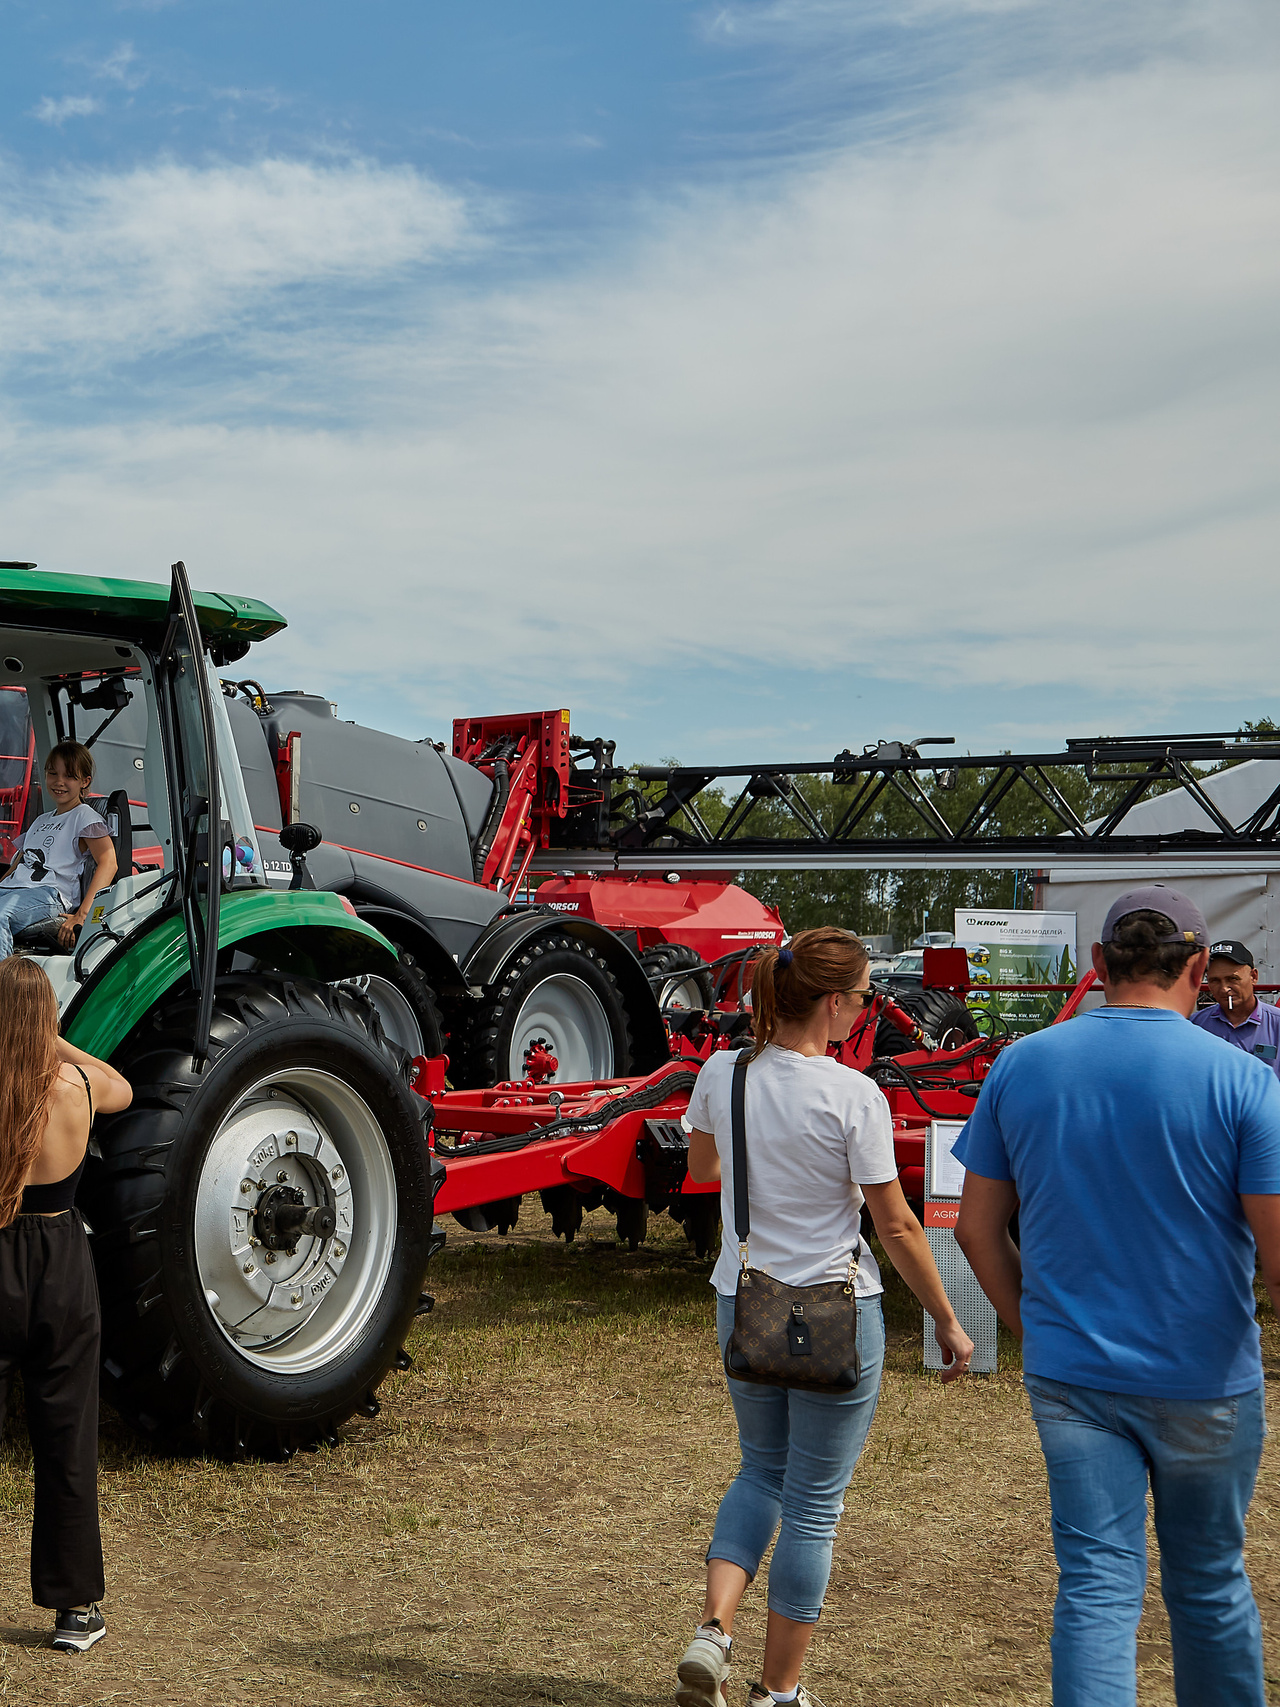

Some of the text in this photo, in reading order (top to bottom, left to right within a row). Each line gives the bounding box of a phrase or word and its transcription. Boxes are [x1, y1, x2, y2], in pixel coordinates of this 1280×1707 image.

[271, 861, 280, 870] 12
[548, 902, 579, 911] ORSCH
[1032, 928, 1063, 936] МОДЕЛЕЙ
[252, 1142, 276, 1168] 50kg
